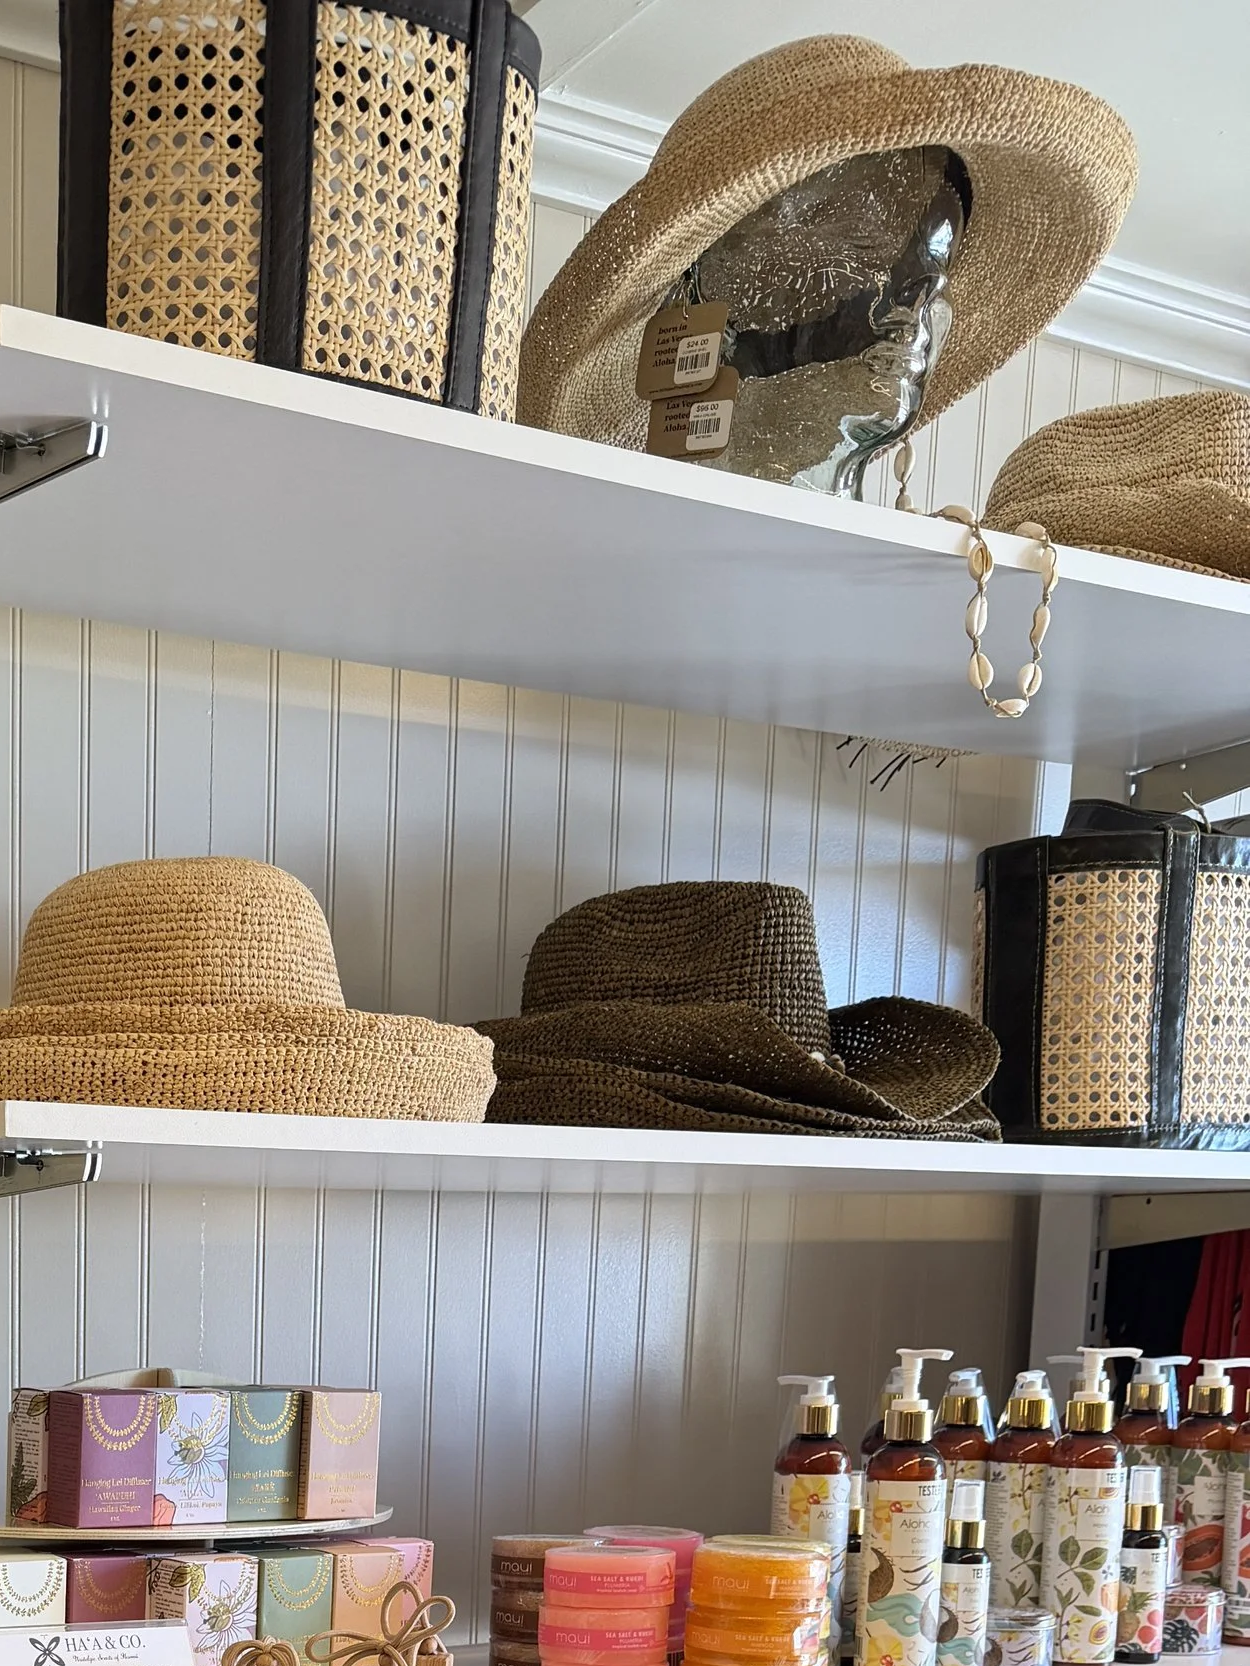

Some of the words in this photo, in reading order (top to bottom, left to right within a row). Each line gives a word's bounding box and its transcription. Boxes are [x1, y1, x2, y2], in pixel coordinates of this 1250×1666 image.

[501, 1561, 532, 1573] maui
[550, 1574, 577, 1587] maui
[713, 1576, 750, 1590] maui
[495, 1611, 524, 1627] maui
[105, 1636, 117, 1650] &
[119, 1635, 146, 1649] CO.
[556, 1632, 590, 1644] maui
